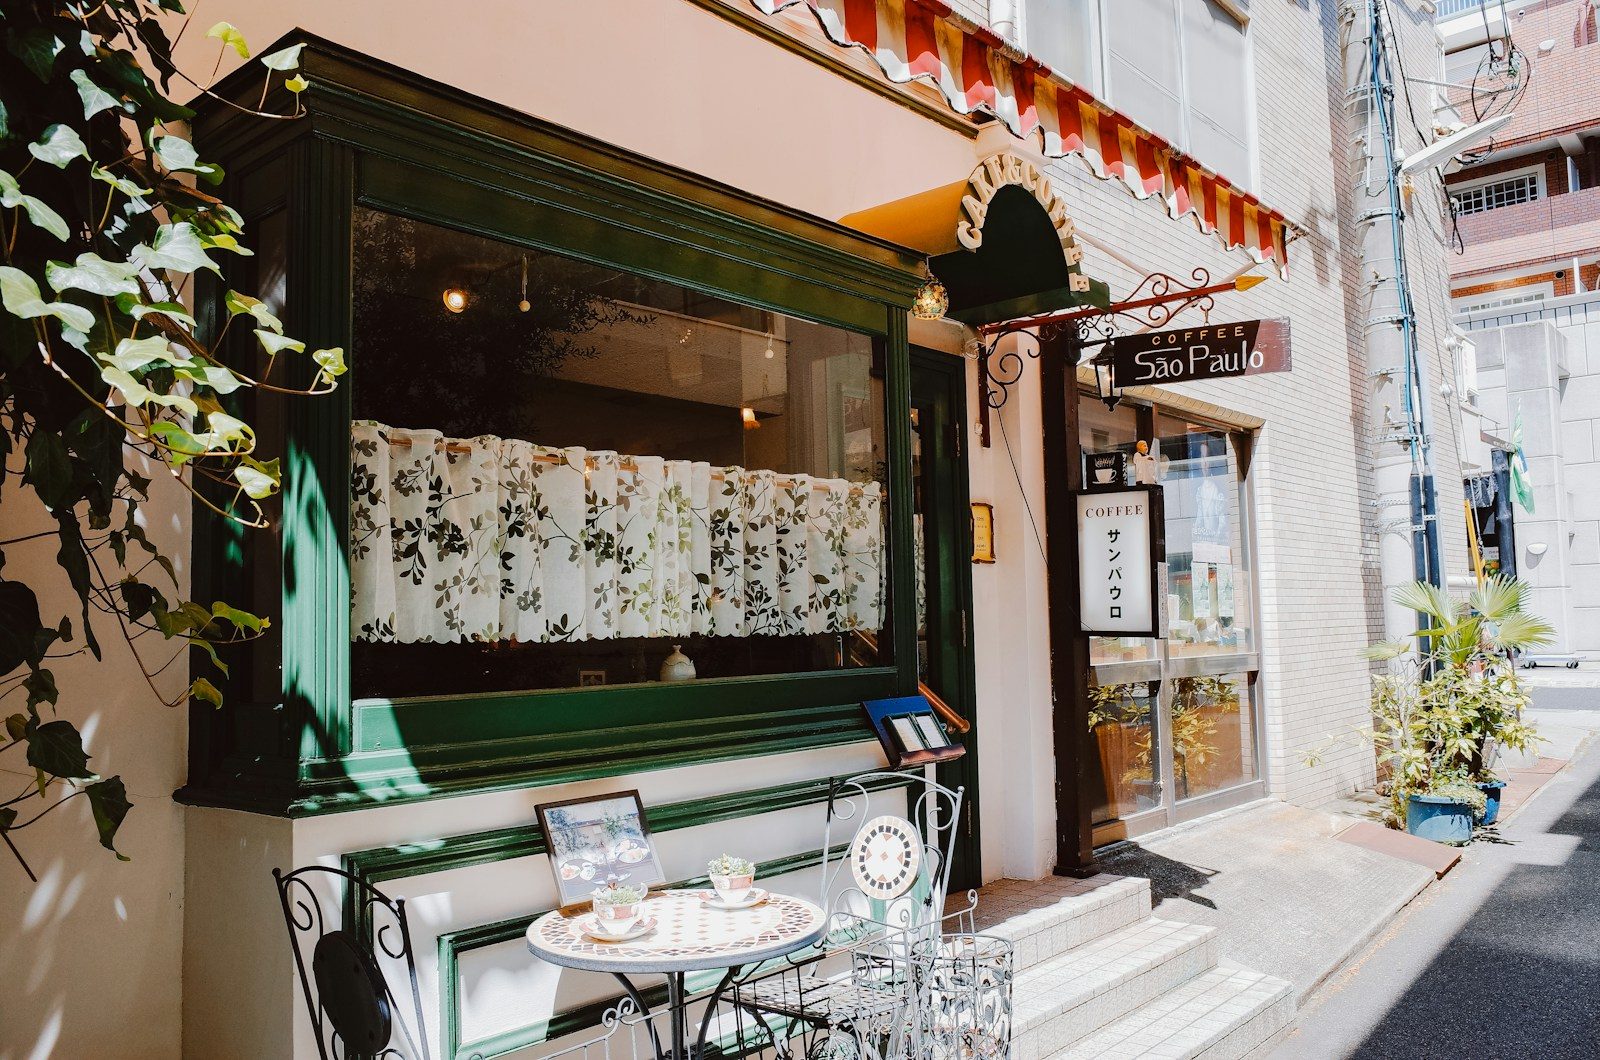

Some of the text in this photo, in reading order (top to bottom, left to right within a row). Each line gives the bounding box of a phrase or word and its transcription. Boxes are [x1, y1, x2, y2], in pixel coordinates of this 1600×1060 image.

[1151, 326, 1245, 346] COFFEE
[1134, 340, 1264, 381] São Paulo
[1085, 504, 1144, 518] COFFEE
[1107, 528, 1122, 619] サンパウロ
